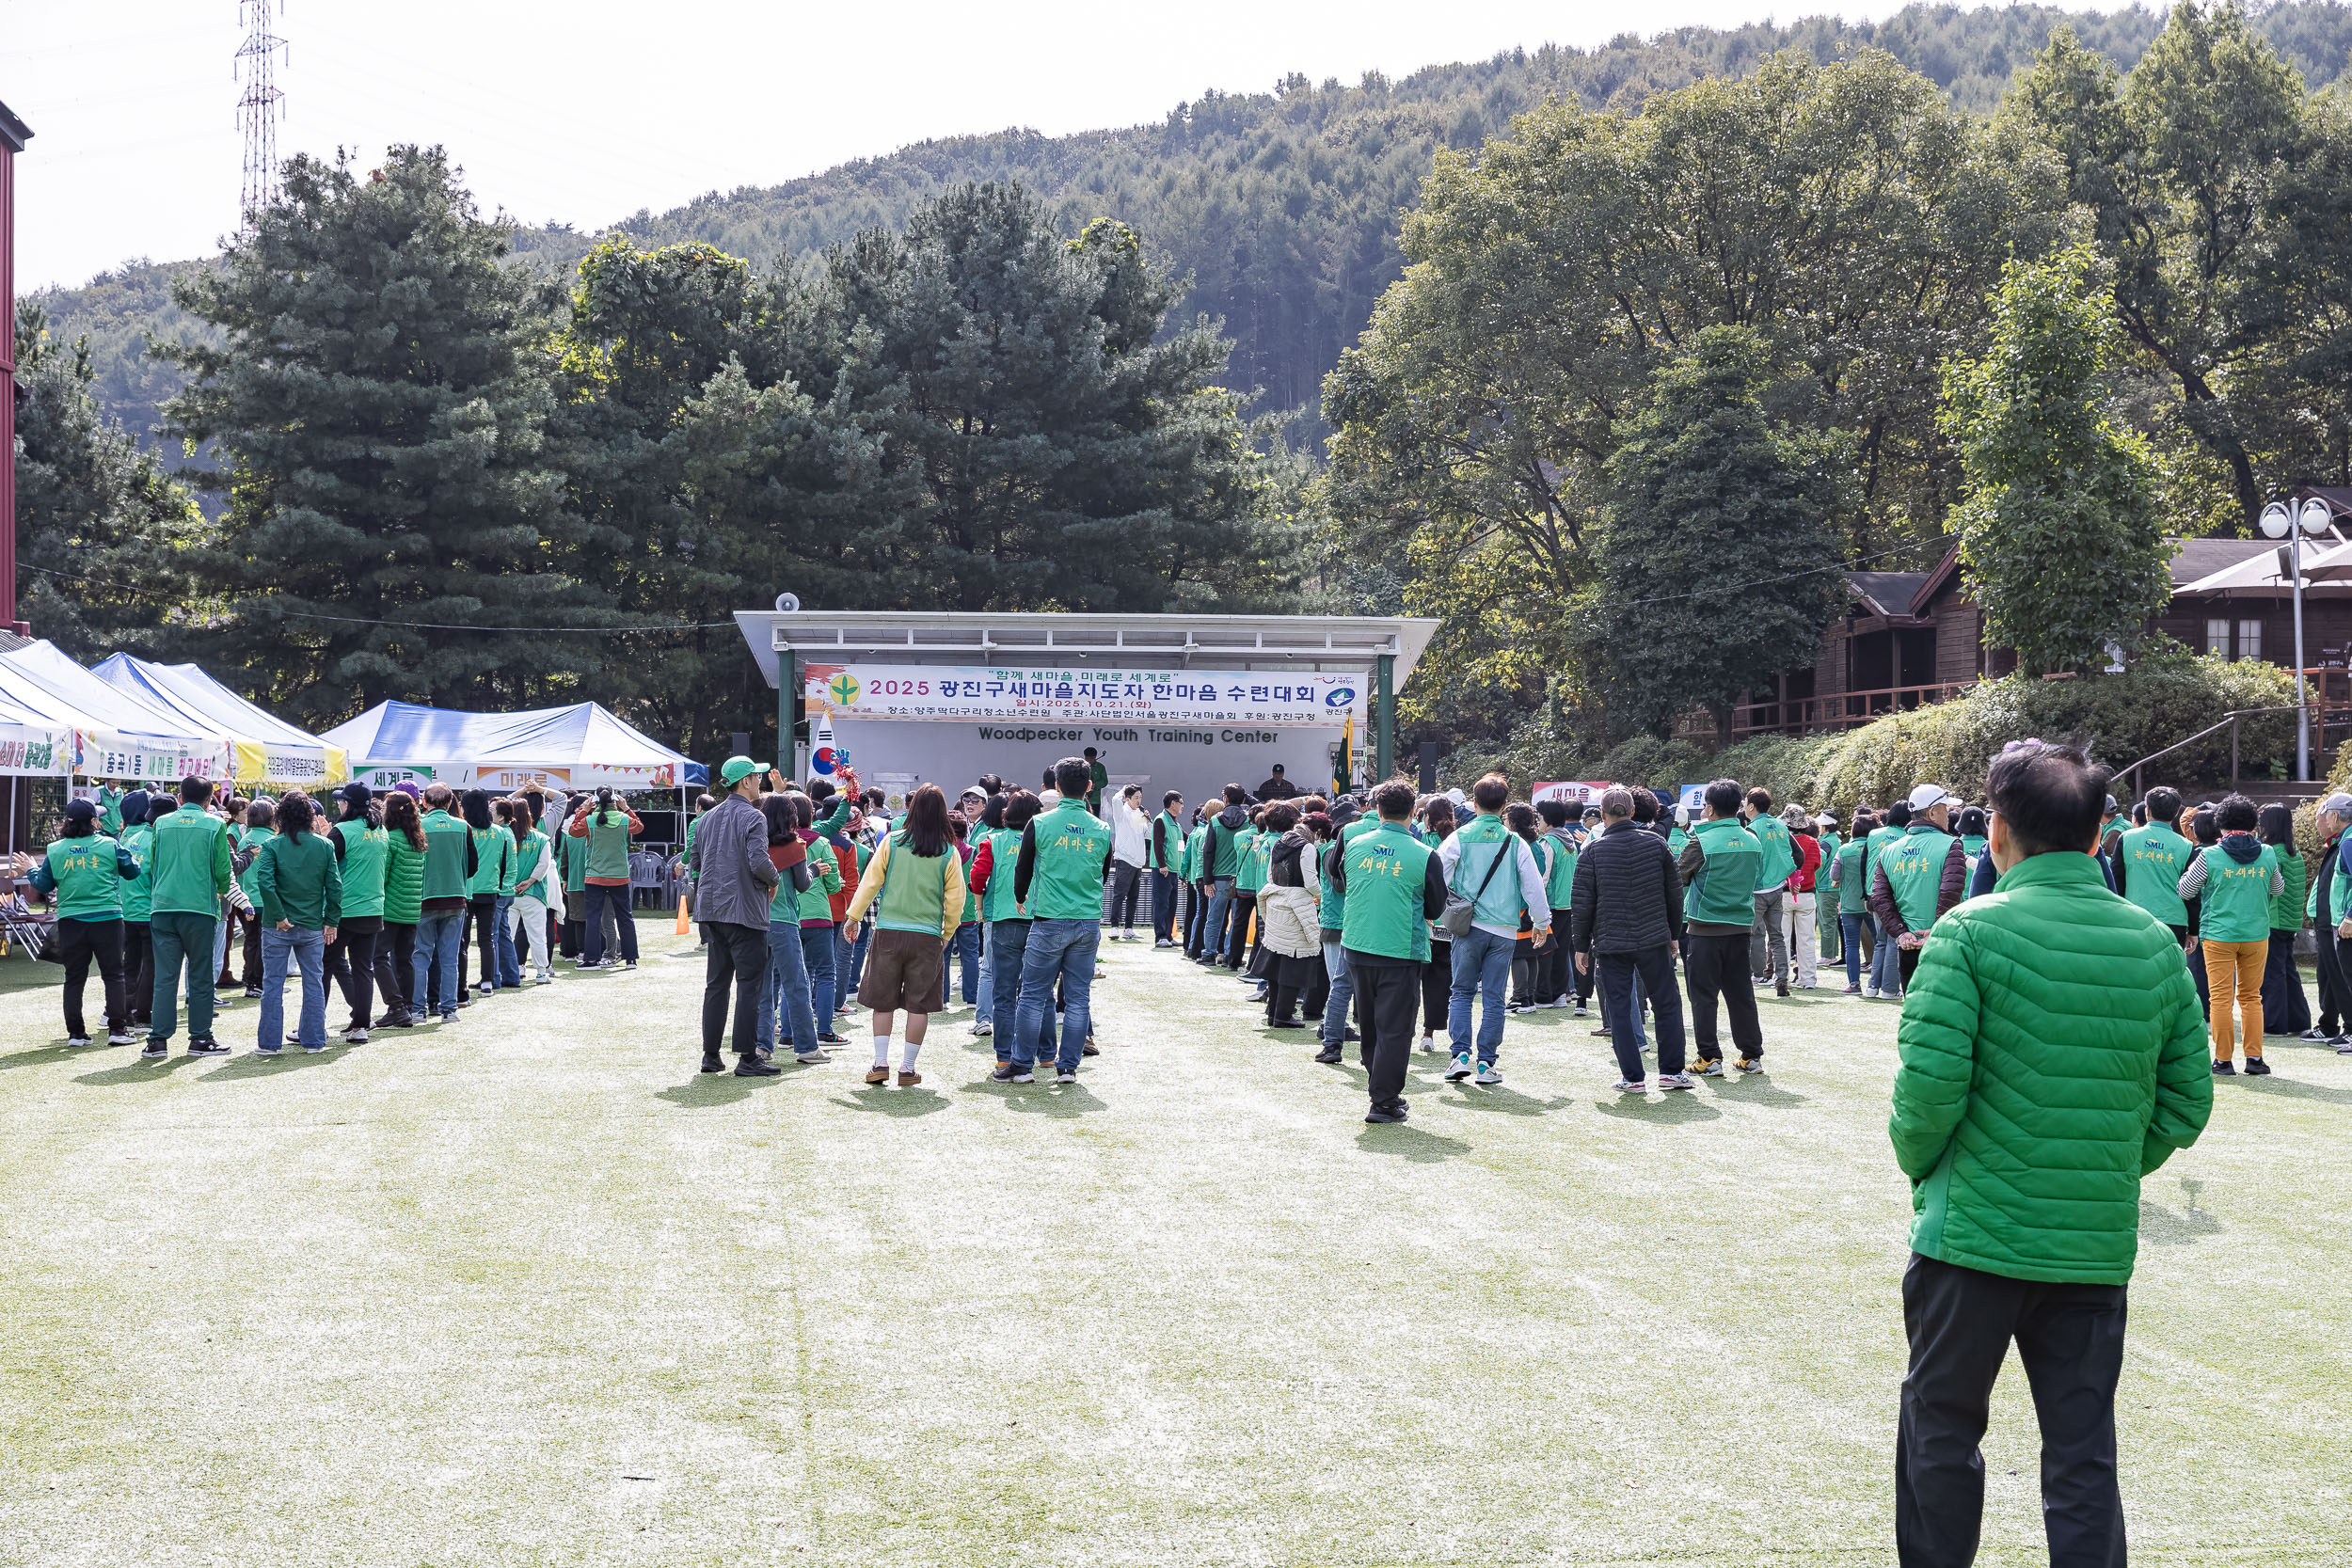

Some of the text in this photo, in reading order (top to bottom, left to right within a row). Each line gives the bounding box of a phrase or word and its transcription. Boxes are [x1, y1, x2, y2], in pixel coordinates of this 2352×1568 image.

[1030, 671, 1123, 682] 새마을,미래로
[869, 679, 1314, 703] 2025 광진구새마을지도자 한마음 수련대회
[1244, 711, 1315, 721] 후원:광진구청
[978, 727, 1279, 744] Woodpecker Youth Training Center
[24, 741, 53, 769] 중곡2동
[106, 752, 142, 776] 중곡1동
[148, 755, 173, 776] 새마을
[1552, 787, 1590, 802] 새마을
[1065, 825, 1085, 835] SMU
[69, 847, 88, 855] SMU
[1054, 835, 1095, 853] 새마을
[2144, 839, 2165, 850] SMU
[1372, 847, 1395, 857] SMU
[1900, 847, 1921, 857] SMU
[2135, 849, 2175, 863] 뉴새마을
[63, 855, 102, 871] 새마을
[1358, 857, 1404, 877] 새마을
[1892, 858, 1931, 876] 새마을
[2223, 866, 2266, 879] 뉴새마을
